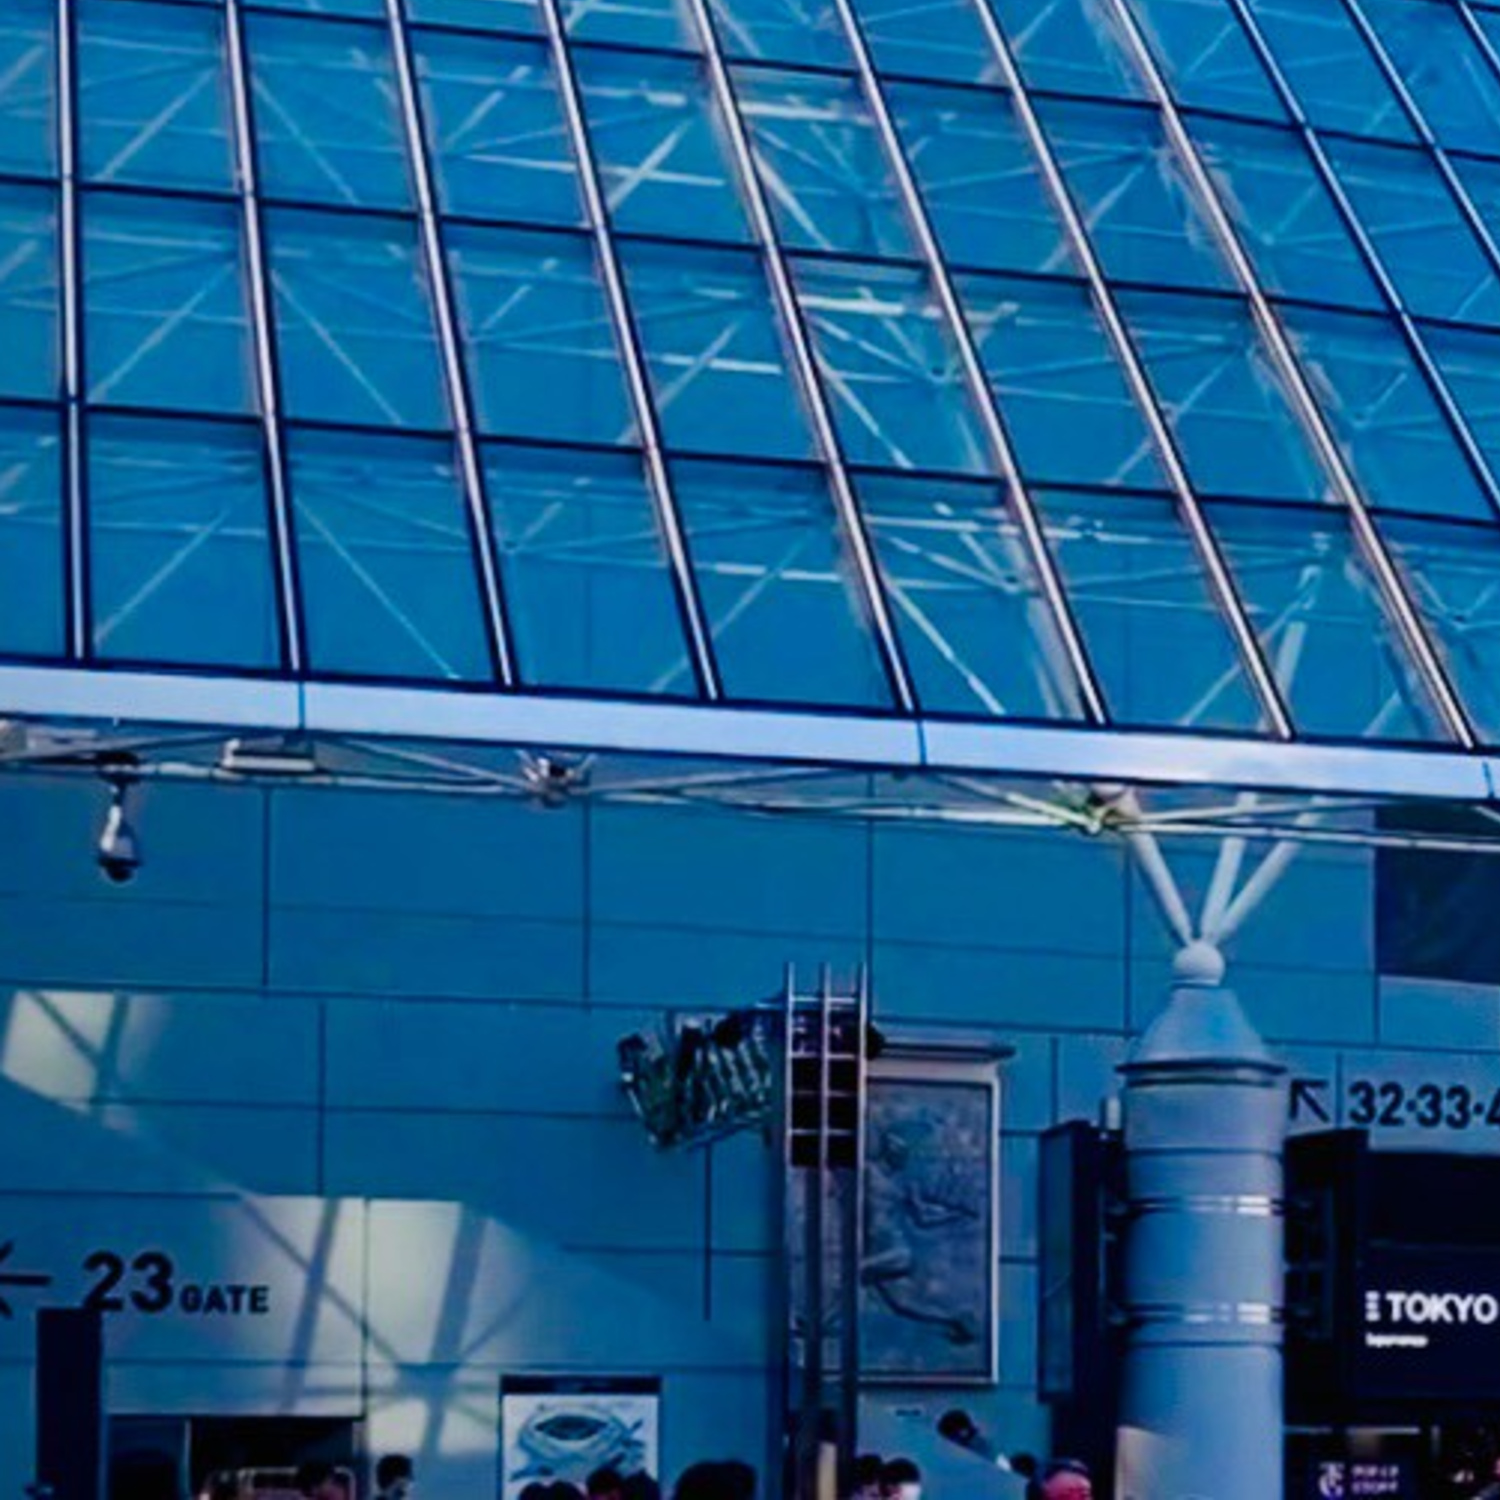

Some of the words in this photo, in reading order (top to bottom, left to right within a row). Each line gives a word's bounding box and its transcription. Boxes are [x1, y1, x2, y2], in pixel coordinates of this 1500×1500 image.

[83, 1251, 175, 1313] 23
[179, 1285, 270, 1315] GATE
[1384, 1291, 1499, 1324] TOKYO
